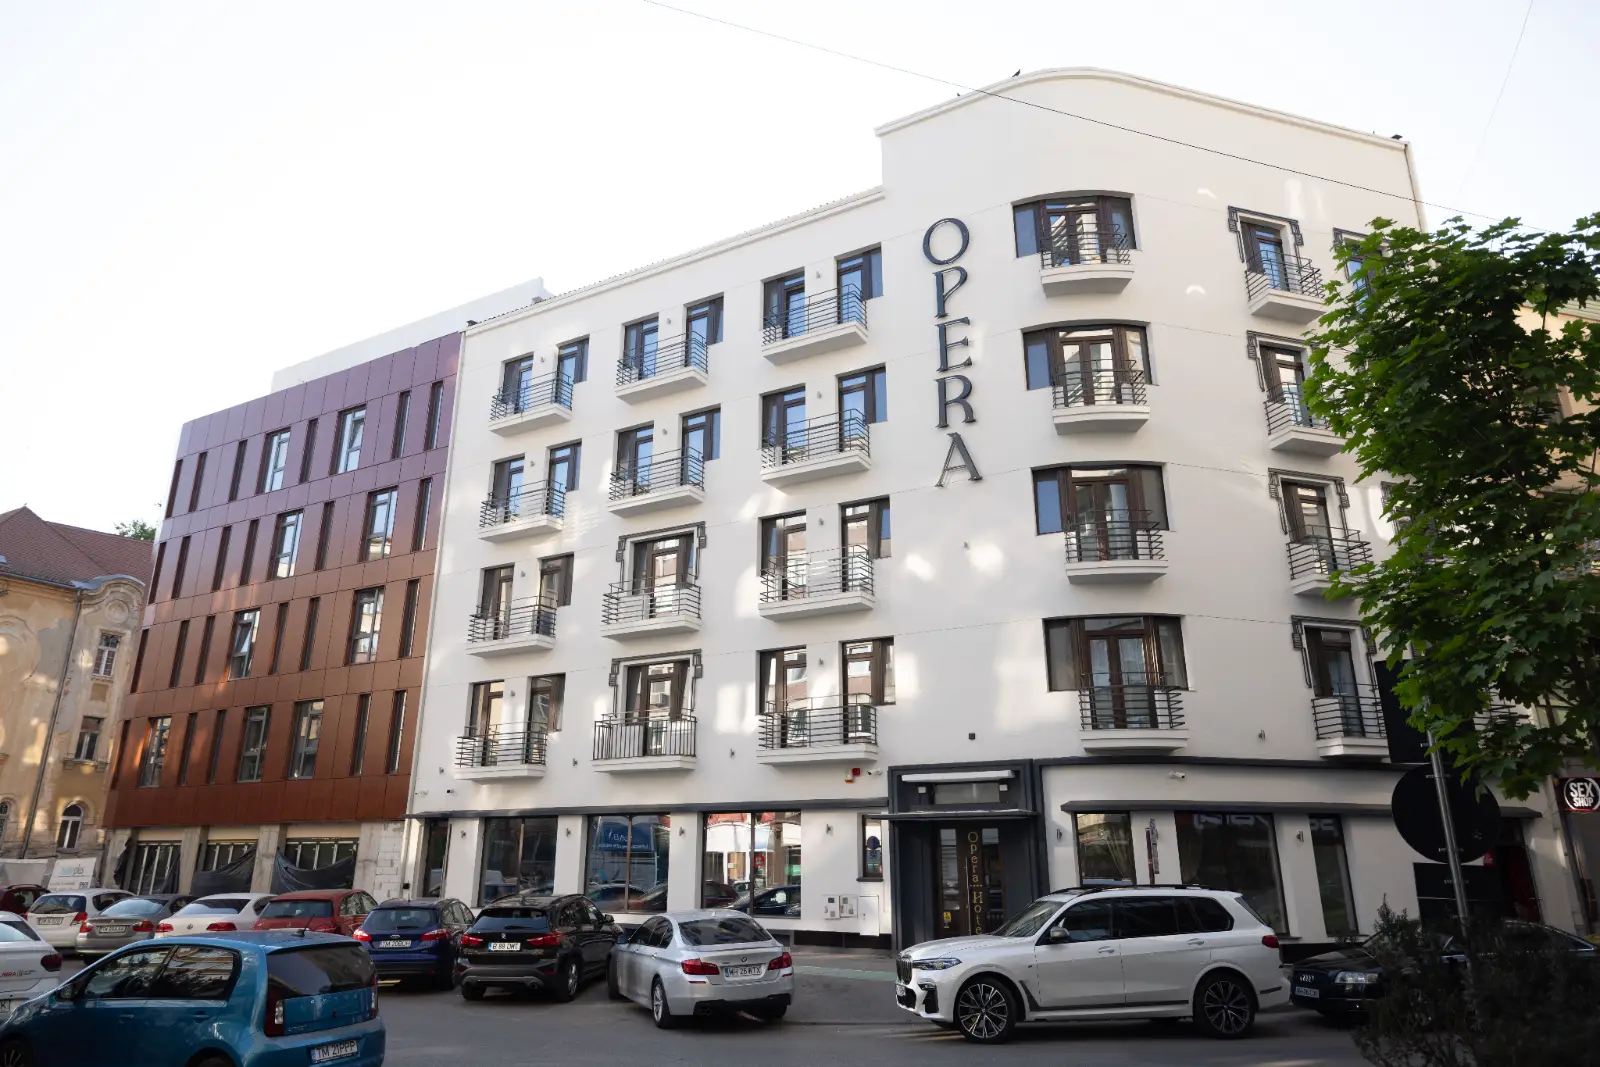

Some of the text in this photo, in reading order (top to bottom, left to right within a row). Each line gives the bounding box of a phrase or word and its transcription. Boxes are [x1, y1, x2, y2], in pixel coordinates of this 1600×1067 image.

[922, 217, 983, 488] OPERA
[1569, 782, 1595, 798] SEX
[1573, 797, 1594, 807] SHOP
[967, 831, 983, 935] Opera Hote
